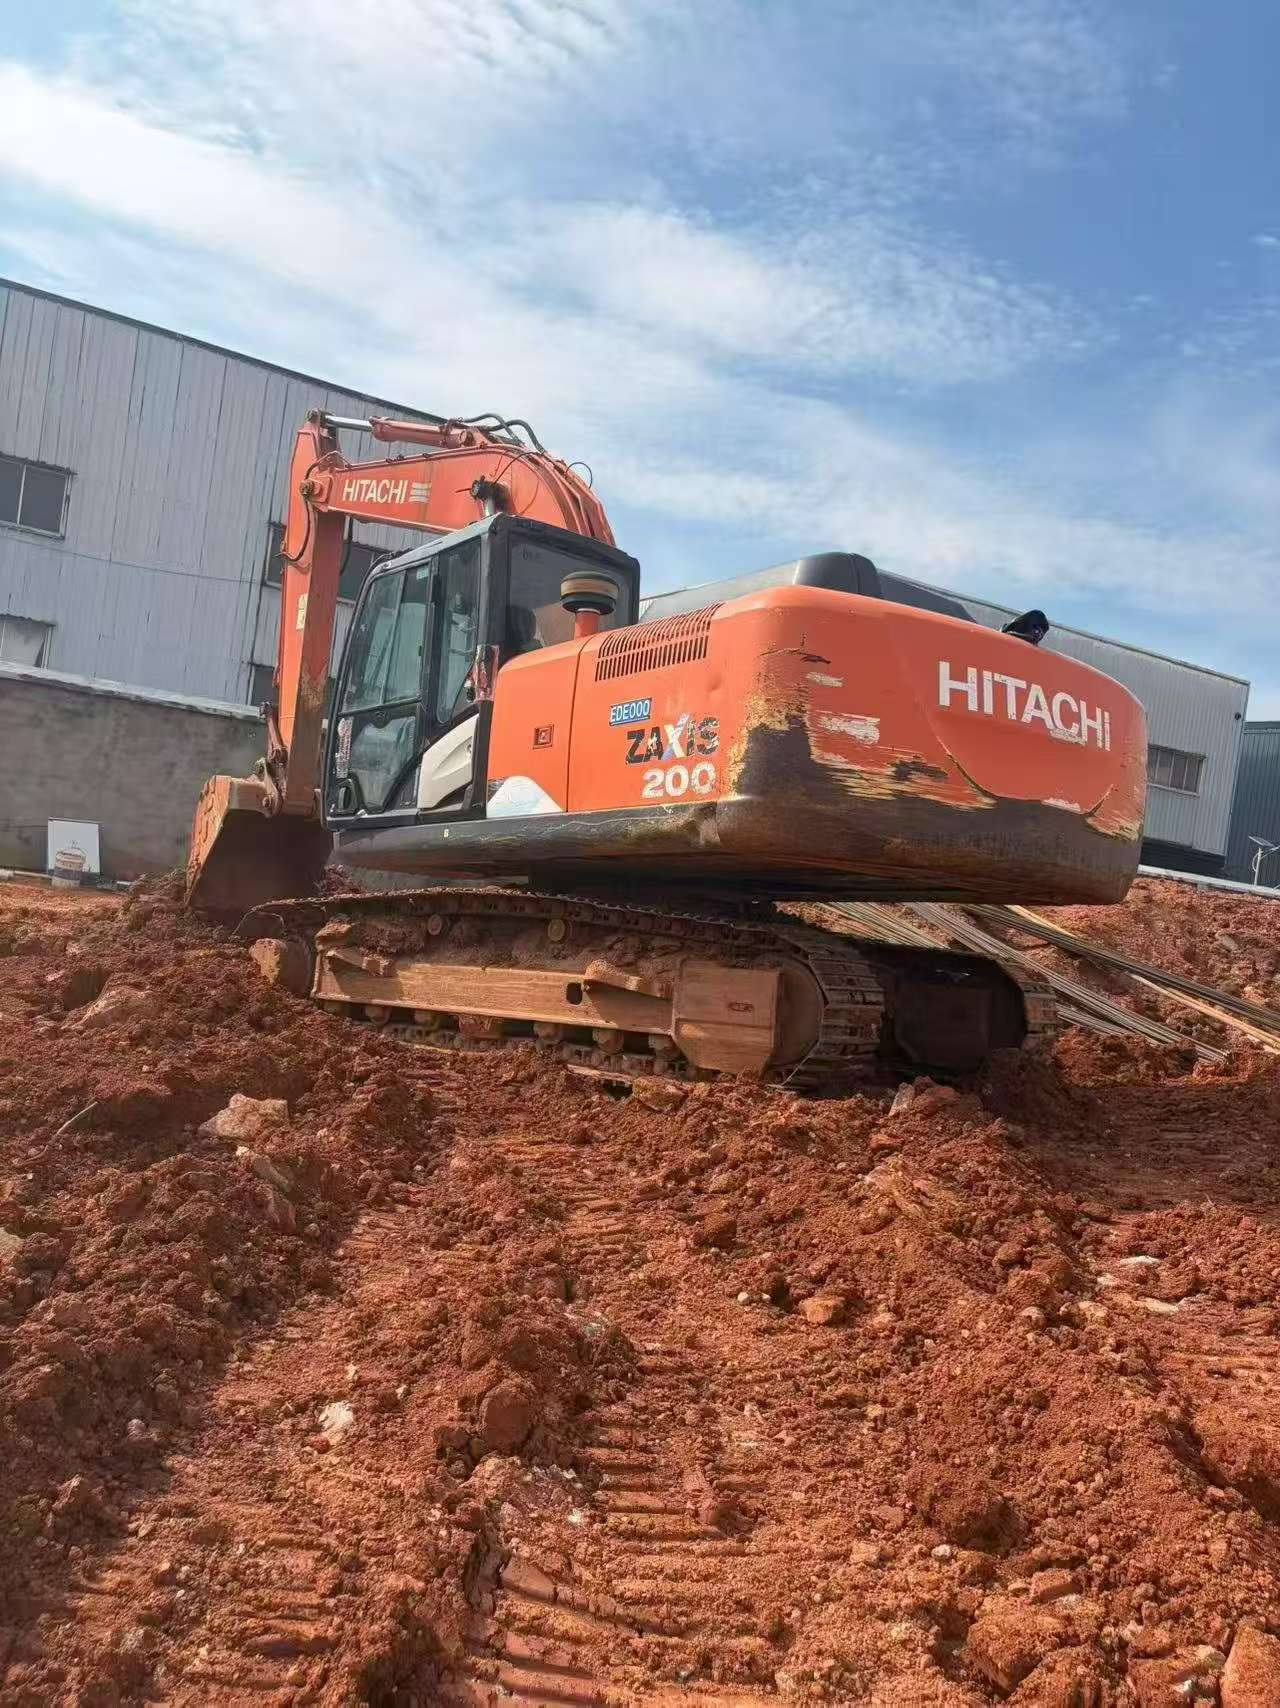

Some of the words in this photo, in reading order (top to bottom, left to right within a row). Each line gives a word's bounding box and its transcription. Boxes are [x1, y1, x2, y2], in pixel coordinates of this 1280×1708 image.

[342, 479, 408, 504] HITACHI
[938, 660, 1111, 751] HITACHI
[625, 713, 720, 765] ZAXIS
[641, 761, 716, 798] 200
